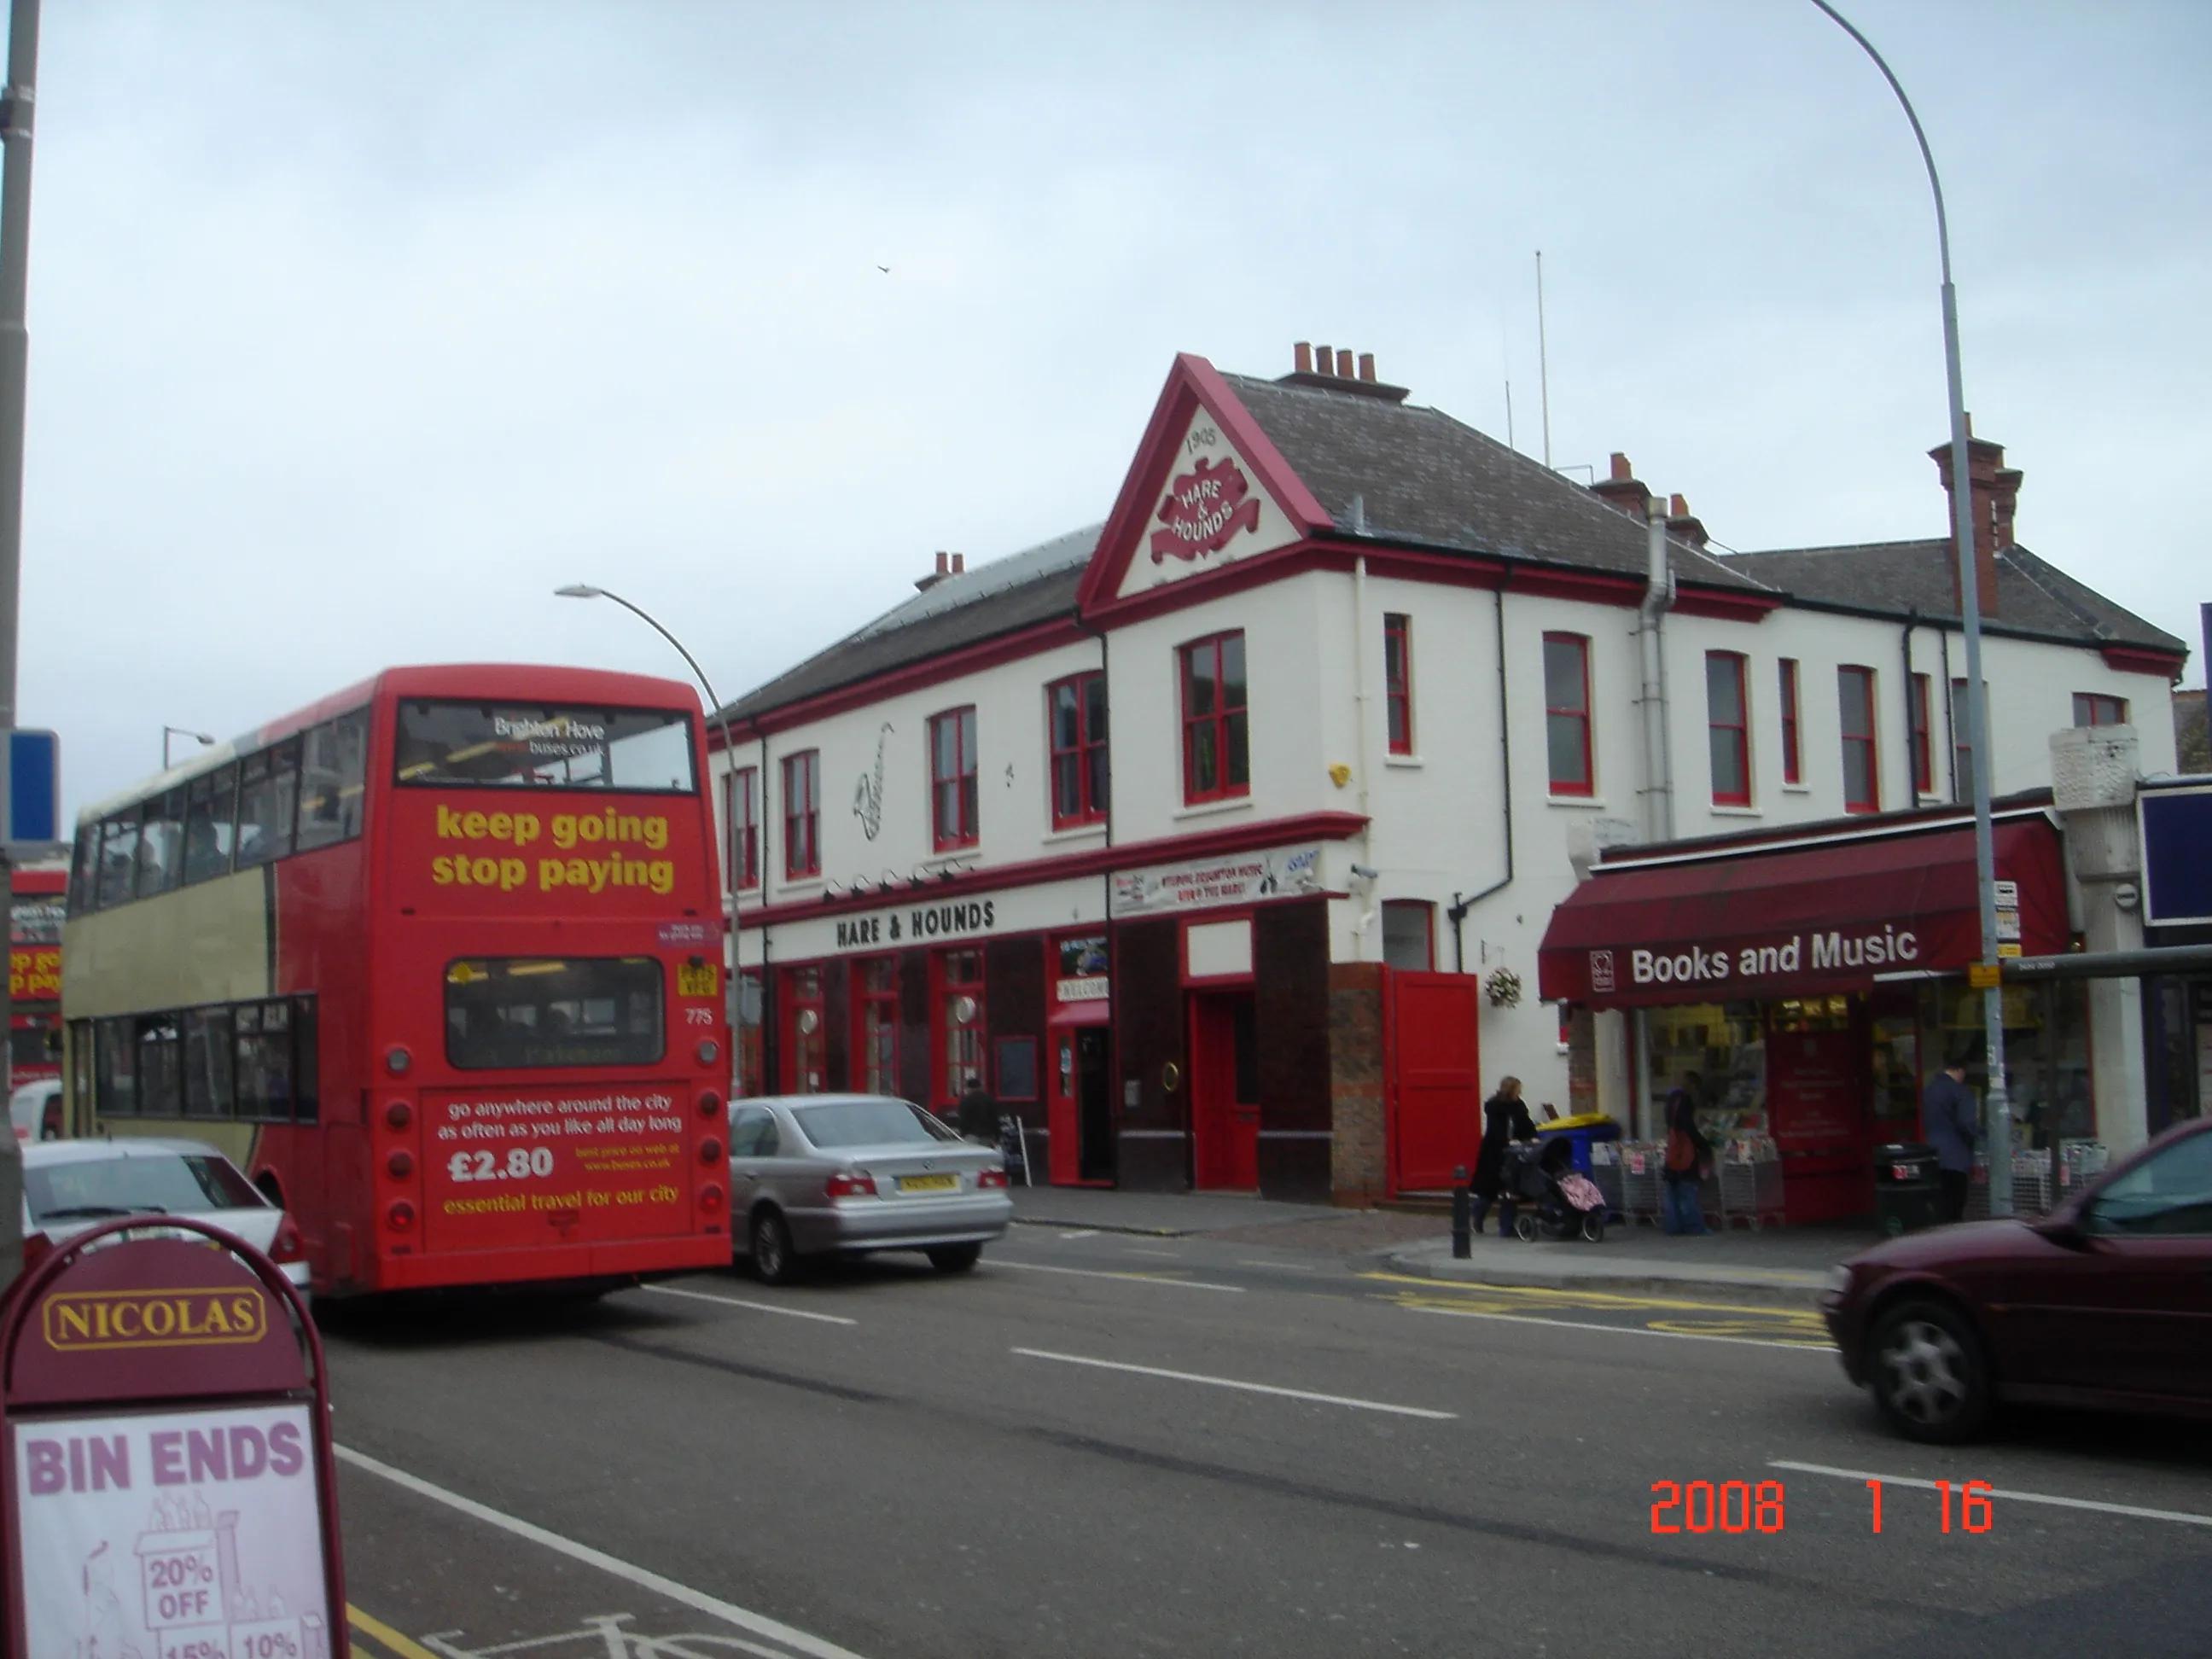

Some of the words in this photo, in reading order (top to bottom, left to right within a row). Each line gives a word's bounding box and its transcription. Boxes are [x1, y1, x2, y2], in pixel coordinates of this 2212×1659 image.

[1181, 480, 1221, 509] HARE
[1172, 501, 1233, 541] HOUNDS
[565, 720, 605, 741] Hove
[436, 804, 541, 847] keep
[551, 805, 669, 850] going
[432, 855, 527, 891] stop
[538, 852, 675, 894] paying
[837, 917, 879, 948] HARE
[889, 914, 901, 940] &
[911, 900, 995, 937] HOUNDS
[1631, 946, 1729, 984] Books
[1738, 936, 1801, 976] and
[1811, 925, 1919, 969] Music
[448, 1103, 470, 1121] go
[474, 1099, 554, 1120] anywhere
[556, 1096, 612, 1114] around
[615, 1095, 641, 1111] the
[644, 1093, 672, 1112] city
[438, 1126, 457, 1140] as
[461, 1122, 505, 1138] often
[509, 1123, 528, 1138] as
[531, 1123, 561, 1139] you
[564, 1118, 593, 1135] like
[597, 1116, 615, 1133] all
[618, 1116, 646, 1135] day
[649, 1115, 683, 1134] long
[446, 1147, 554, 1183] £2.80
[443, 1191, 527, 1215] essential
[531, 1190, 581, 1209] travel
[586, 1189, 610, 1207] for
[616, 1190, 643, 1205] our
[649, 1185, 678, 1205] city
[55, 1298, 255, 1340] NICOLAS
[26, 1434, 131, 1497] BIN
[149, 1420, 304, 1487] ENDS
[149, 1553, 213, 1588] 20%
[158, 1590, 210, 1619] OFF
[167, 1640, 226, 1659] 15%
[244, 1632, 297, 1658] 10%
